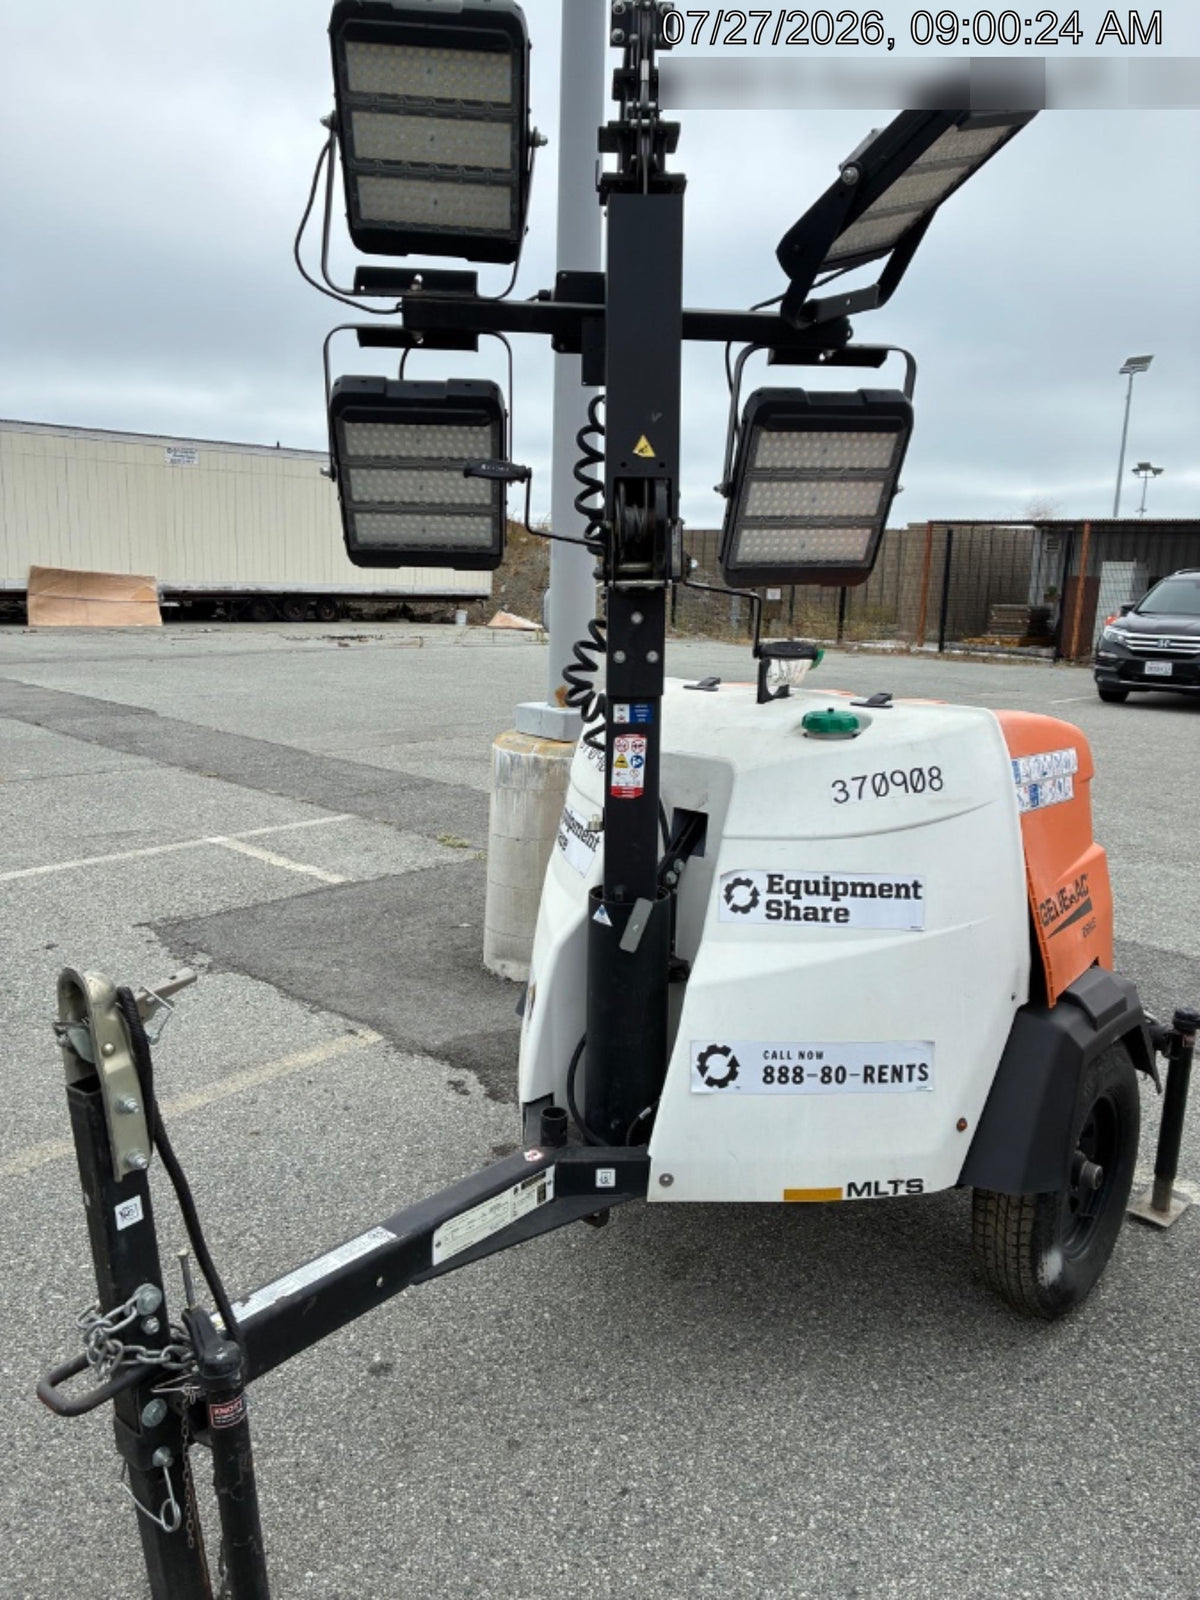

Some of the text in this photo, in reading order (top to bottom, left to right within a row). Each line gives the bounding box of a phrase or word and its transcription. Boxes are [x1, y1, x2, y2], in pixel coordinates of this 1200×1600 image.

[831, 765, 944, 804] 370908
[766, 874, 923, 902] Equipment
[765, 899, 850, 923] Share
[763, 1050, 824, 1060] CALL NOW
[762, 1062, 930, 1085] 888-80-RENTS
[846, 1178, 924, 1198] MLTS
